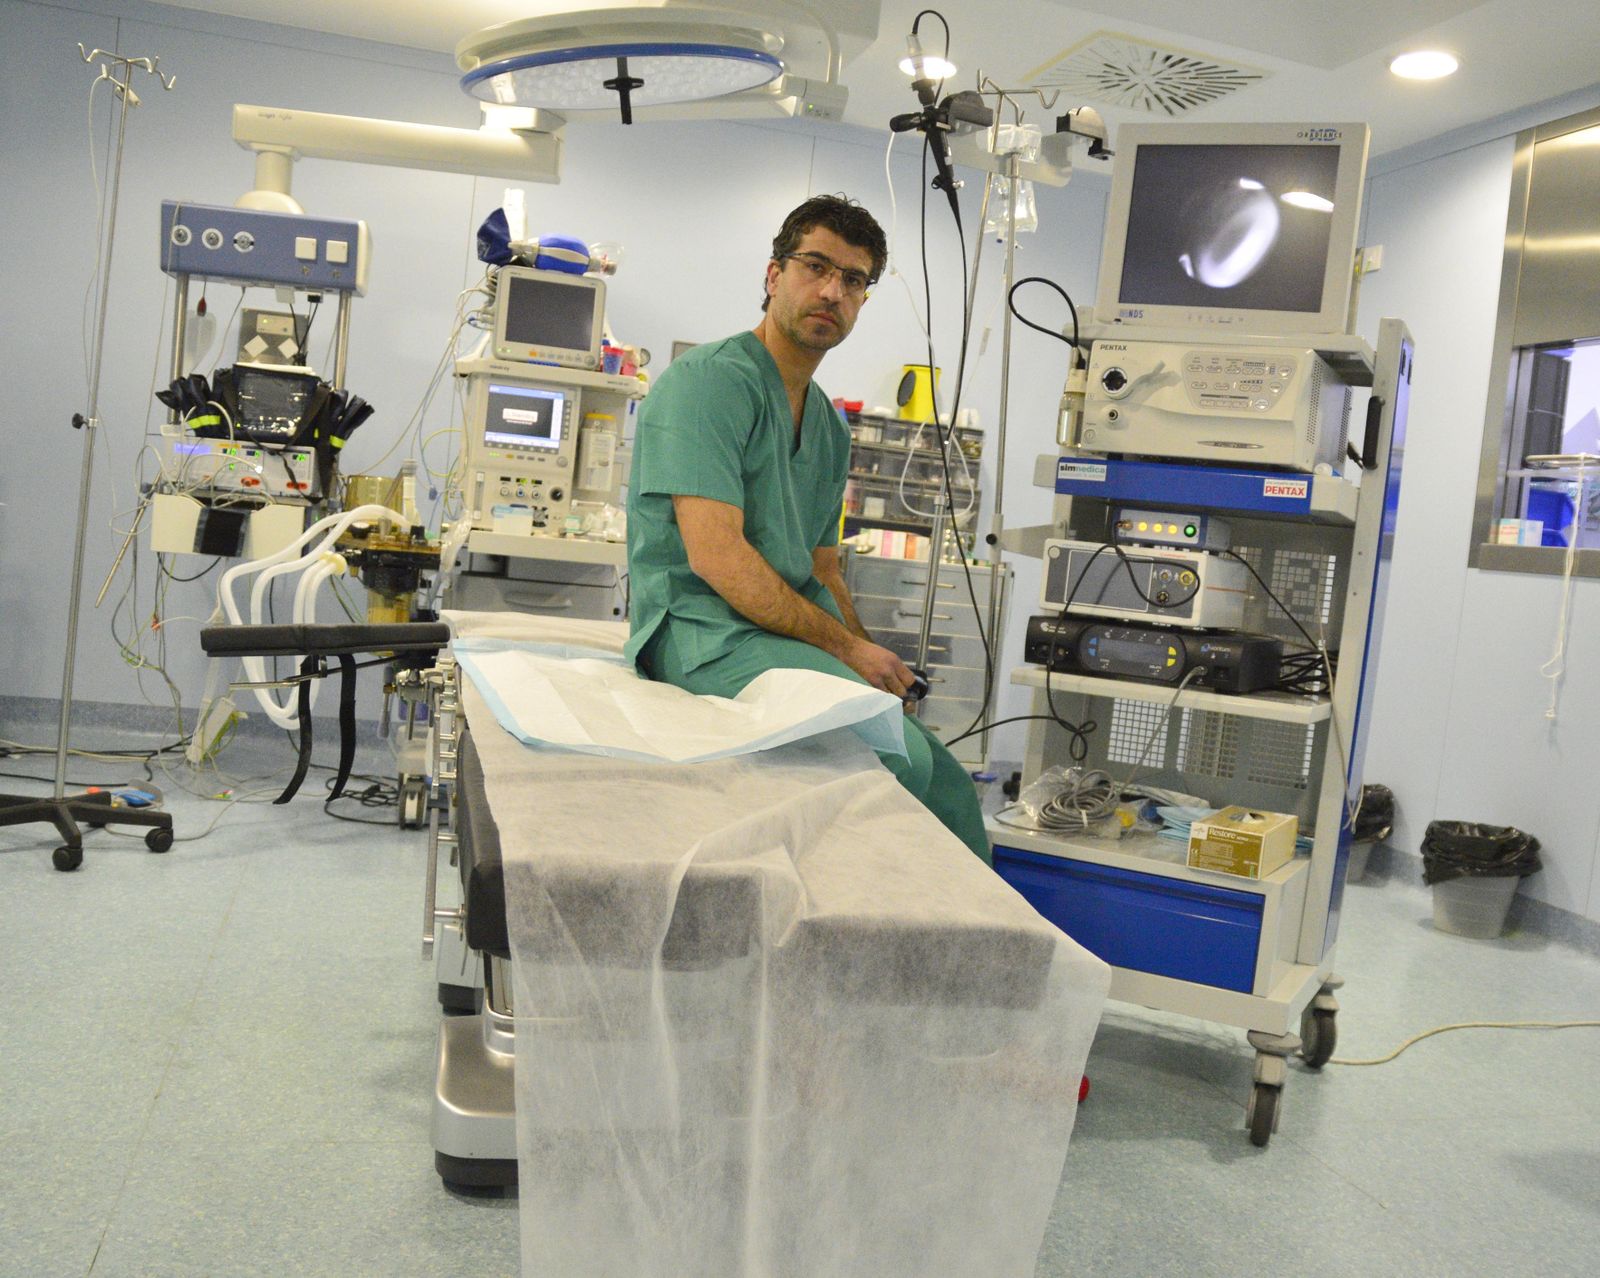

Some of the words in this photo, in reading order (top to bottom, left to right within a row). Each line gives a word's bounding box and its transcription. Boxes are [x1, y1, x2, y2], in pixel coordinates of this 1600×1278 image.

[1128, 309, 1144, 319] NDS
[1264, 485, 1305, 497] PENTAX
[1208, 827, 1237, 840] Restore
